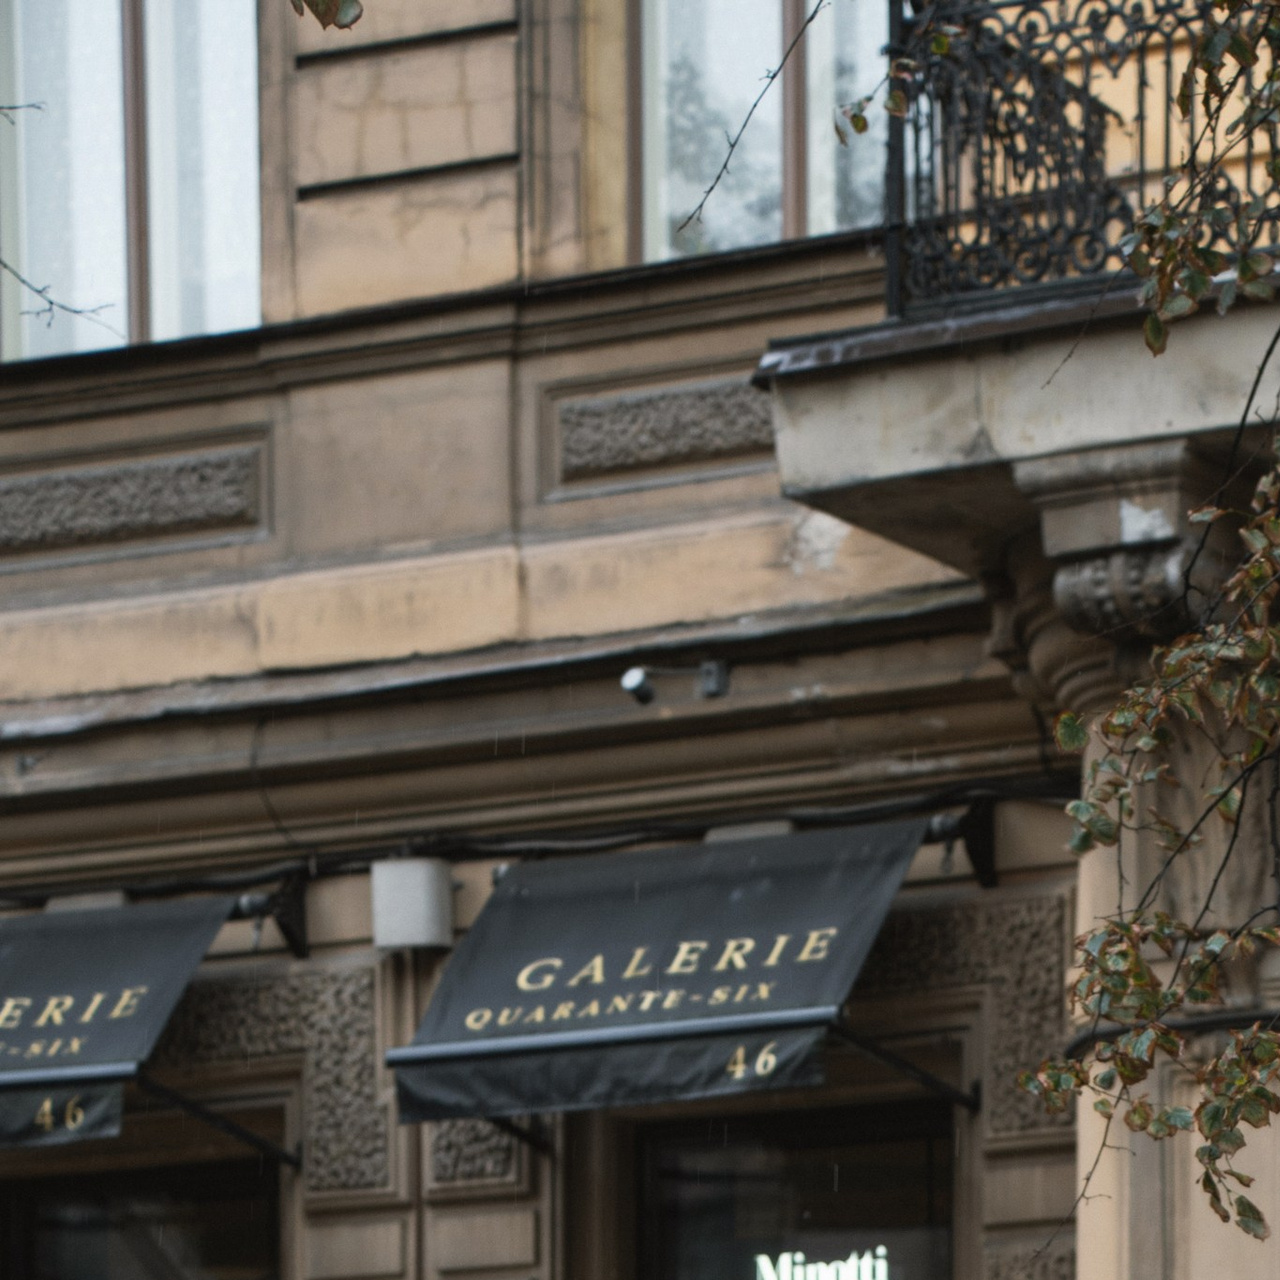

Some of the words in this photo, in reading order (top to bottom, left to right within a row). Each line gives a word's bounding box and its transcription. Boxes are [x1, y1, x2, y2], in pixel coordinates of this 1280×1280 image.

[515, 927, 838, 991] GALERIE
[465, 981, 777, 1031] QUARANTE-SIX
[0, 1035, 88, 1060] -SIX
[726, 1041, 778, 1081] 46
[34, 1095, 85, 1131] 46
